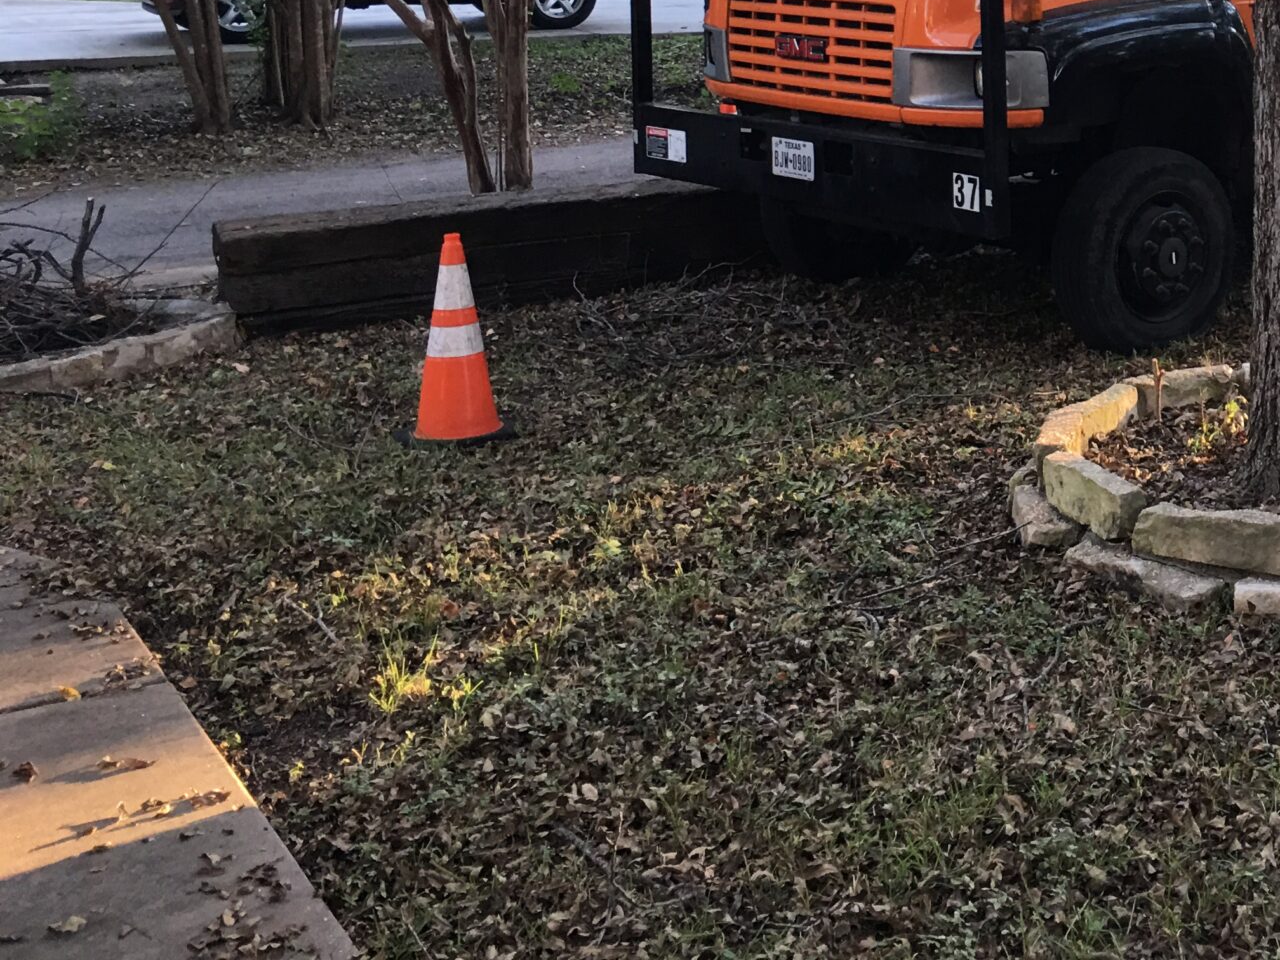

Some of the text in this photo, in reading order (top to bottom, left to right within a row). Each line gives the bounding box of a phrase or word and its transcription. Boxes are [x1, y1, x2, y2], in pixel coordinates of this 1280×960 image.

[774, 37, 824, 60] GMC
[784, 141, 802, 151] TEXAS
[954, 174, 978, 210] 37
